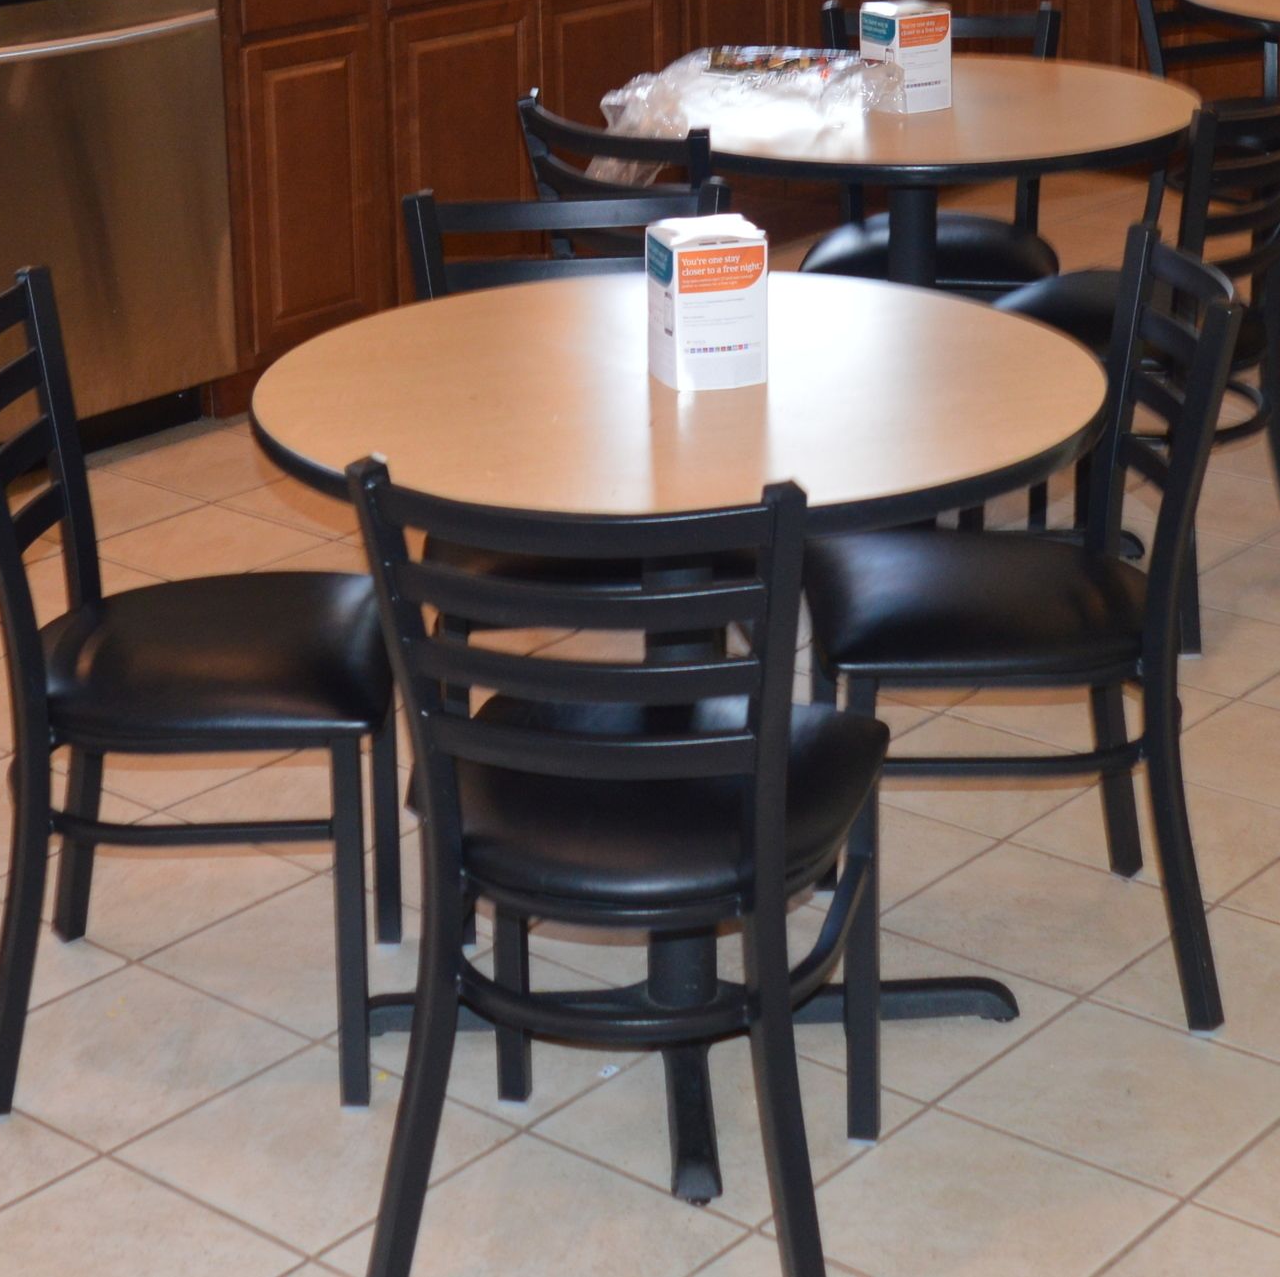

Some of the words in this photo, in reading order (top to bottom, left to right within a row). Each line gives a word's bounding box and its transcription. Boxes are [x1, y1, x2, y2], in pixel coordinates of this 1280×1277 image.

[681, 257, 707, 266] You're
[724, 255, 740, 264] stay
[681, 267, 705, 276] closer
[707, 267, 715, 275] to
[723, 264, 739, 273] free
